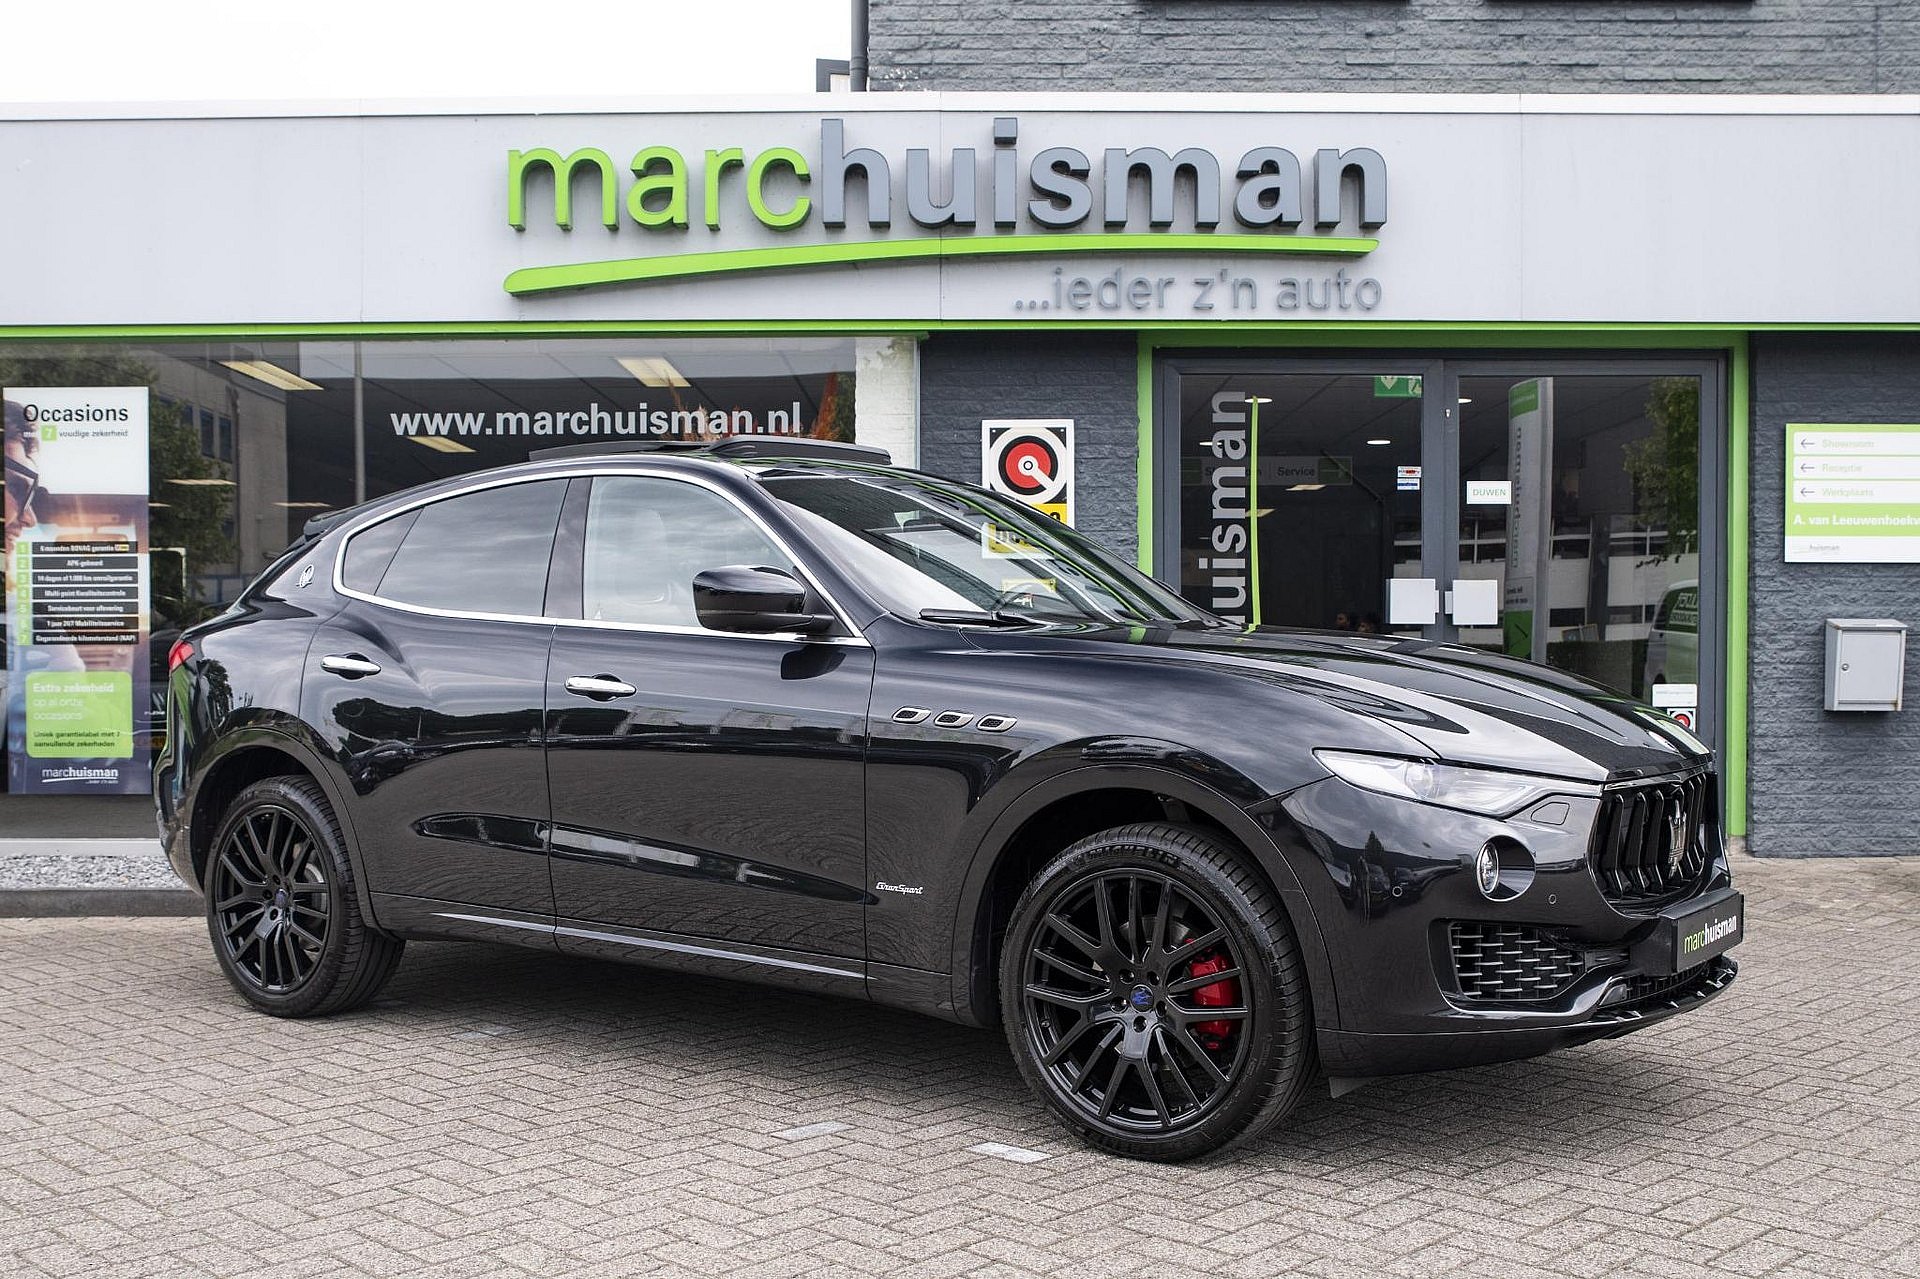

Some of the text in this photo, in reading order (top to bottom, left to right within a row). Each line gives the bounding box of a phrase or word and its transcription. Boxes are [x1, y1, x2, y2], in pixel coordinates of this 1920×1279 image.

[507, 118, 1389, 232] marchuisman
[1191, 268, 1257, 310] z'n
[1276, 267, 1383, 310] auto
[22, 403, 129, 422] Occasions
[390, 401, 802, 436] www.marchuisman.nl
[59, 429, 90, 438] voudige
[91, 428, 129, 437] zekerheid
[1277, 466, 1316, 477] Service
[1472, 488, 1507, 497] DUWEN
[1793, 514, 1806, 526] A.
[1808, 516, 1830, 526] van
[33, 682, 115, 693] Extra zekerheid
[42, 767, 119, 778] marchuisman
[875, 881, 924, 895] GranSport
[1684, 915, 1737, 954] marchuisman
